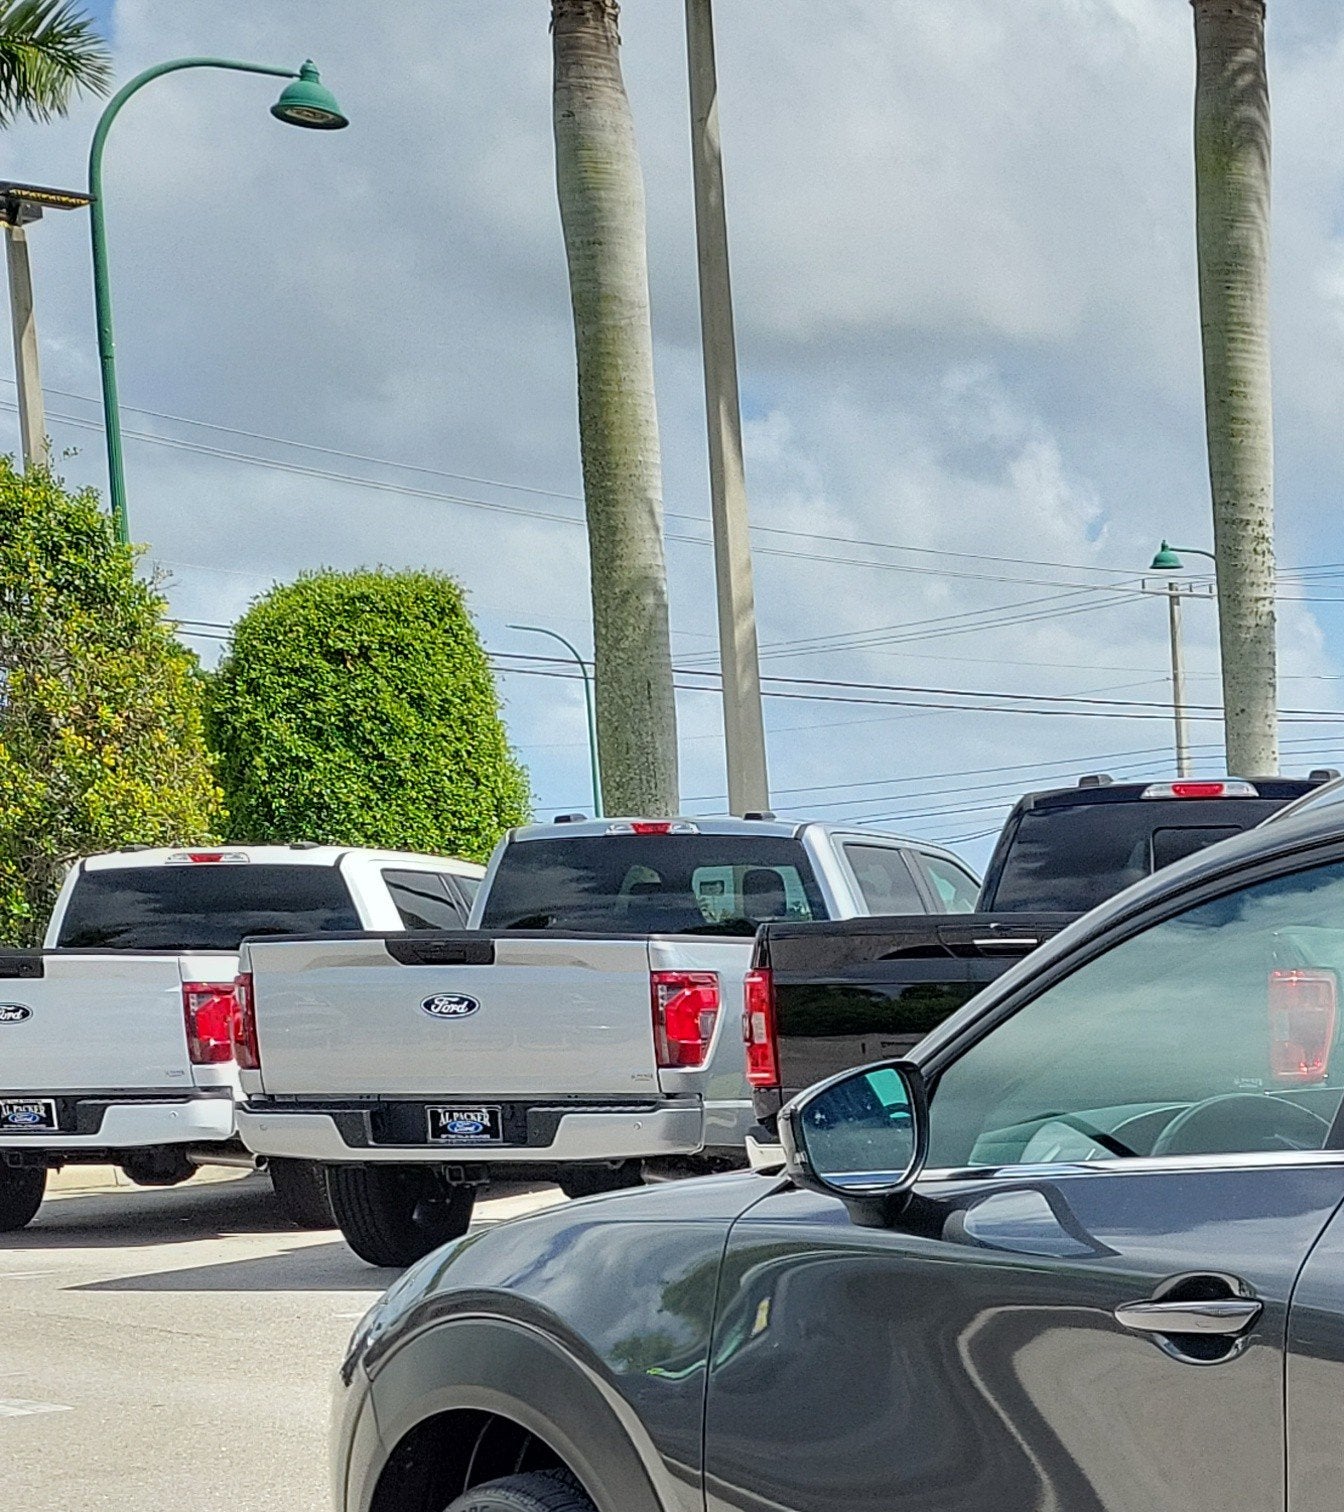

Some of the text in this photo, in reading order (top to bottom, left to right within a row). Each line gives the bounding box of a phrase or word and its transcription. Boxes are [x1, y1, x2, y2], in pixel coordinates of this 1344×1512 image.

[431, 997, 469, 1013] Ford
[439, 1112, 491, 1126] AL PACKER
